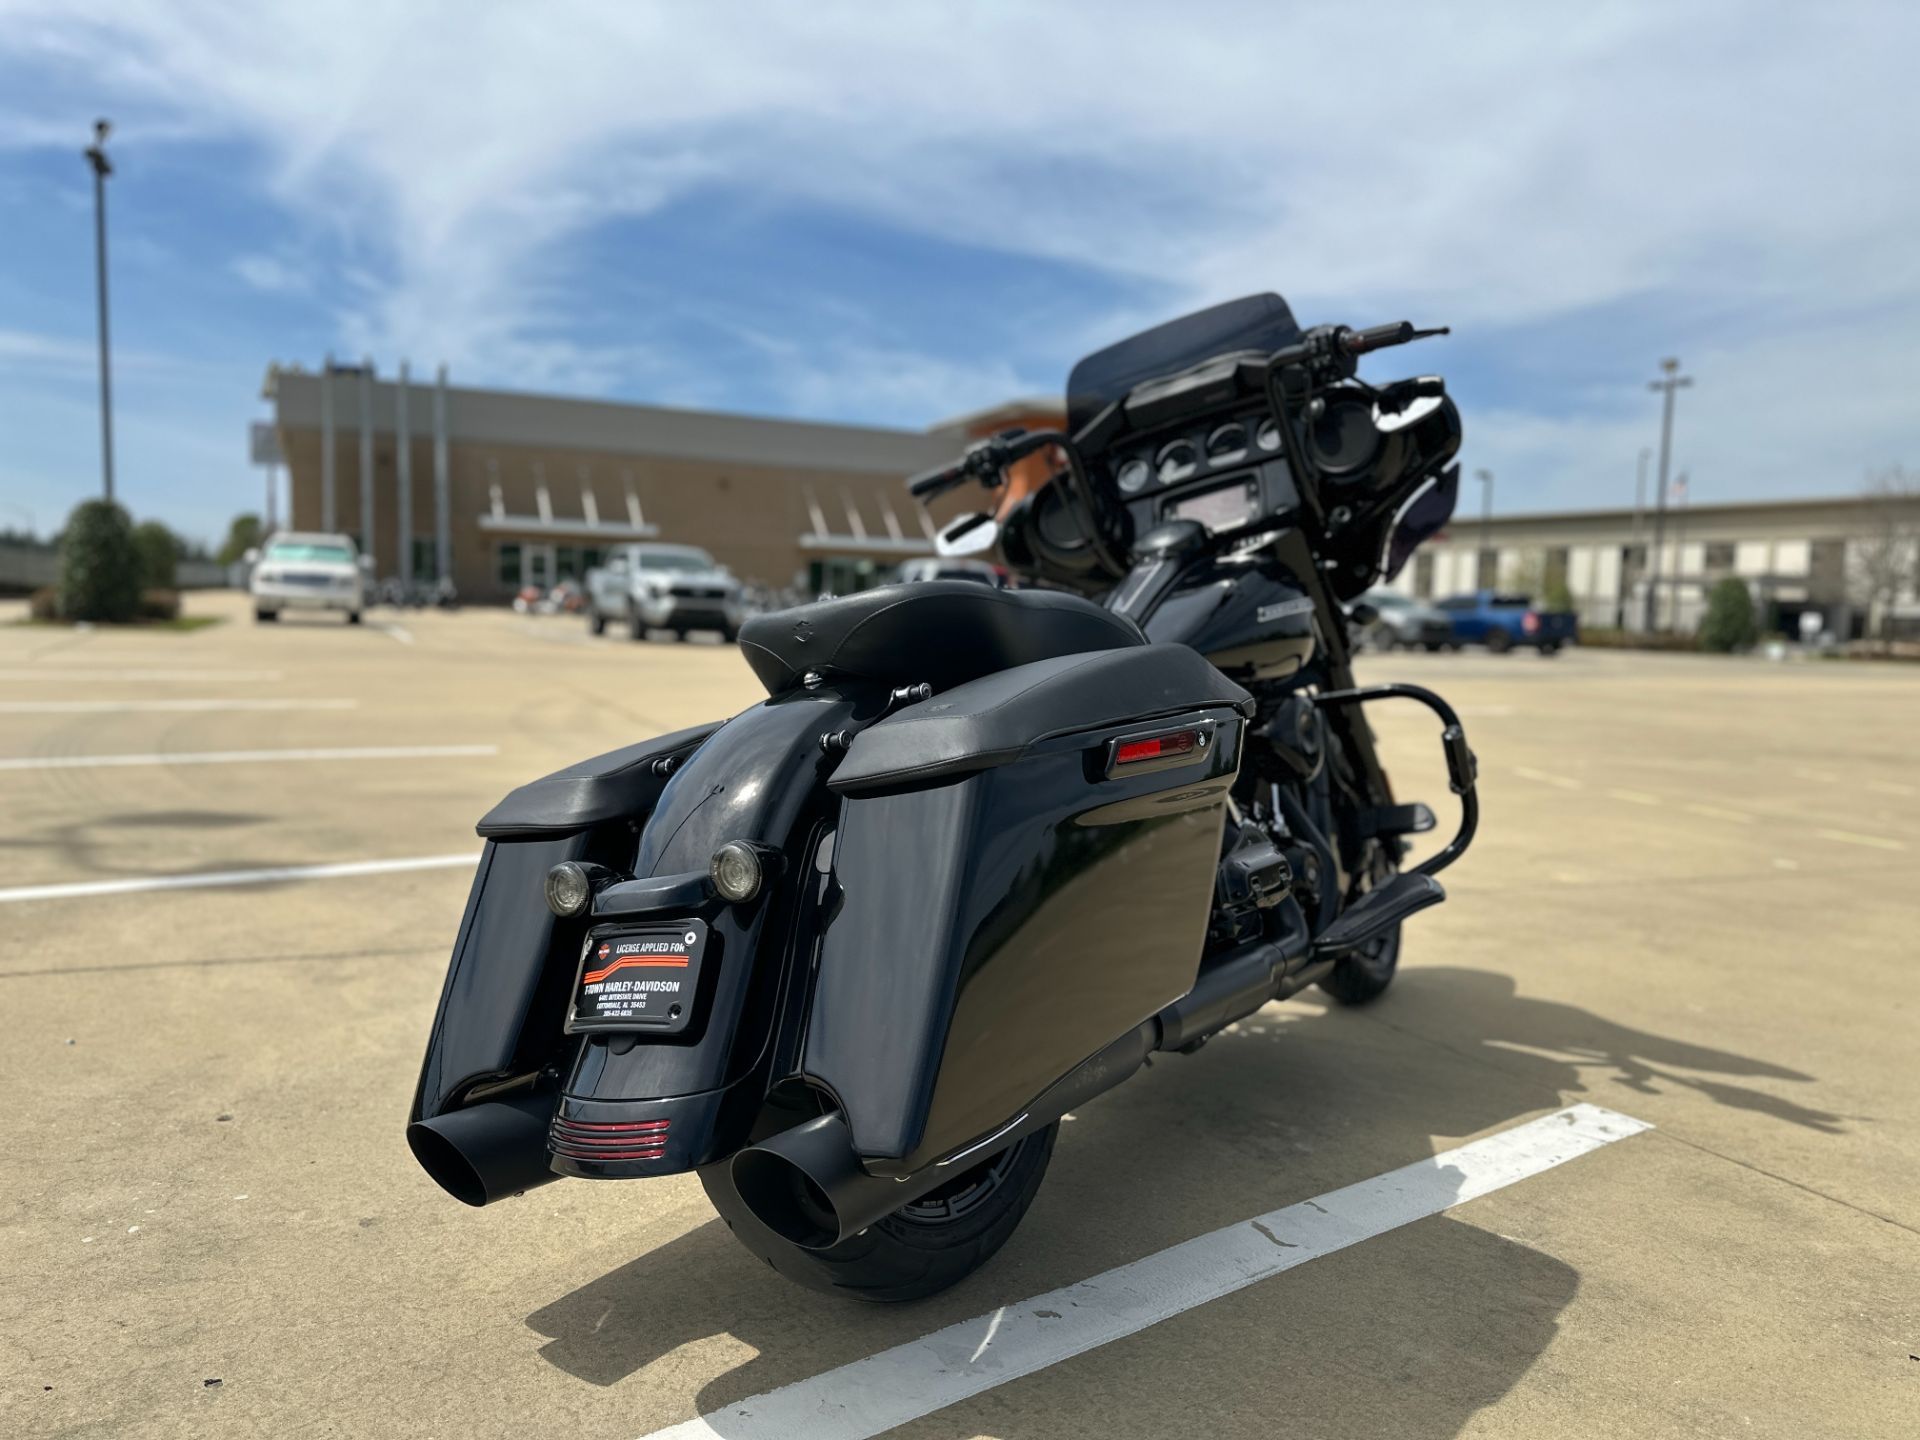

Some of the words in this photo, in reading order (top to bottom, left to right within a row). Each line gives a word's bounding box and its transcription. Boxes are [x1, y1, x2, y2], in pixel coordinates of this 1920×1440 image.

[616, 943, 640, 954] LICENSE
[640, 942, 669, 953] APPLIED
[670, 943, 685, 953] FOR
[605, 981, 680, 993] HARLEY-DAVIDSON
